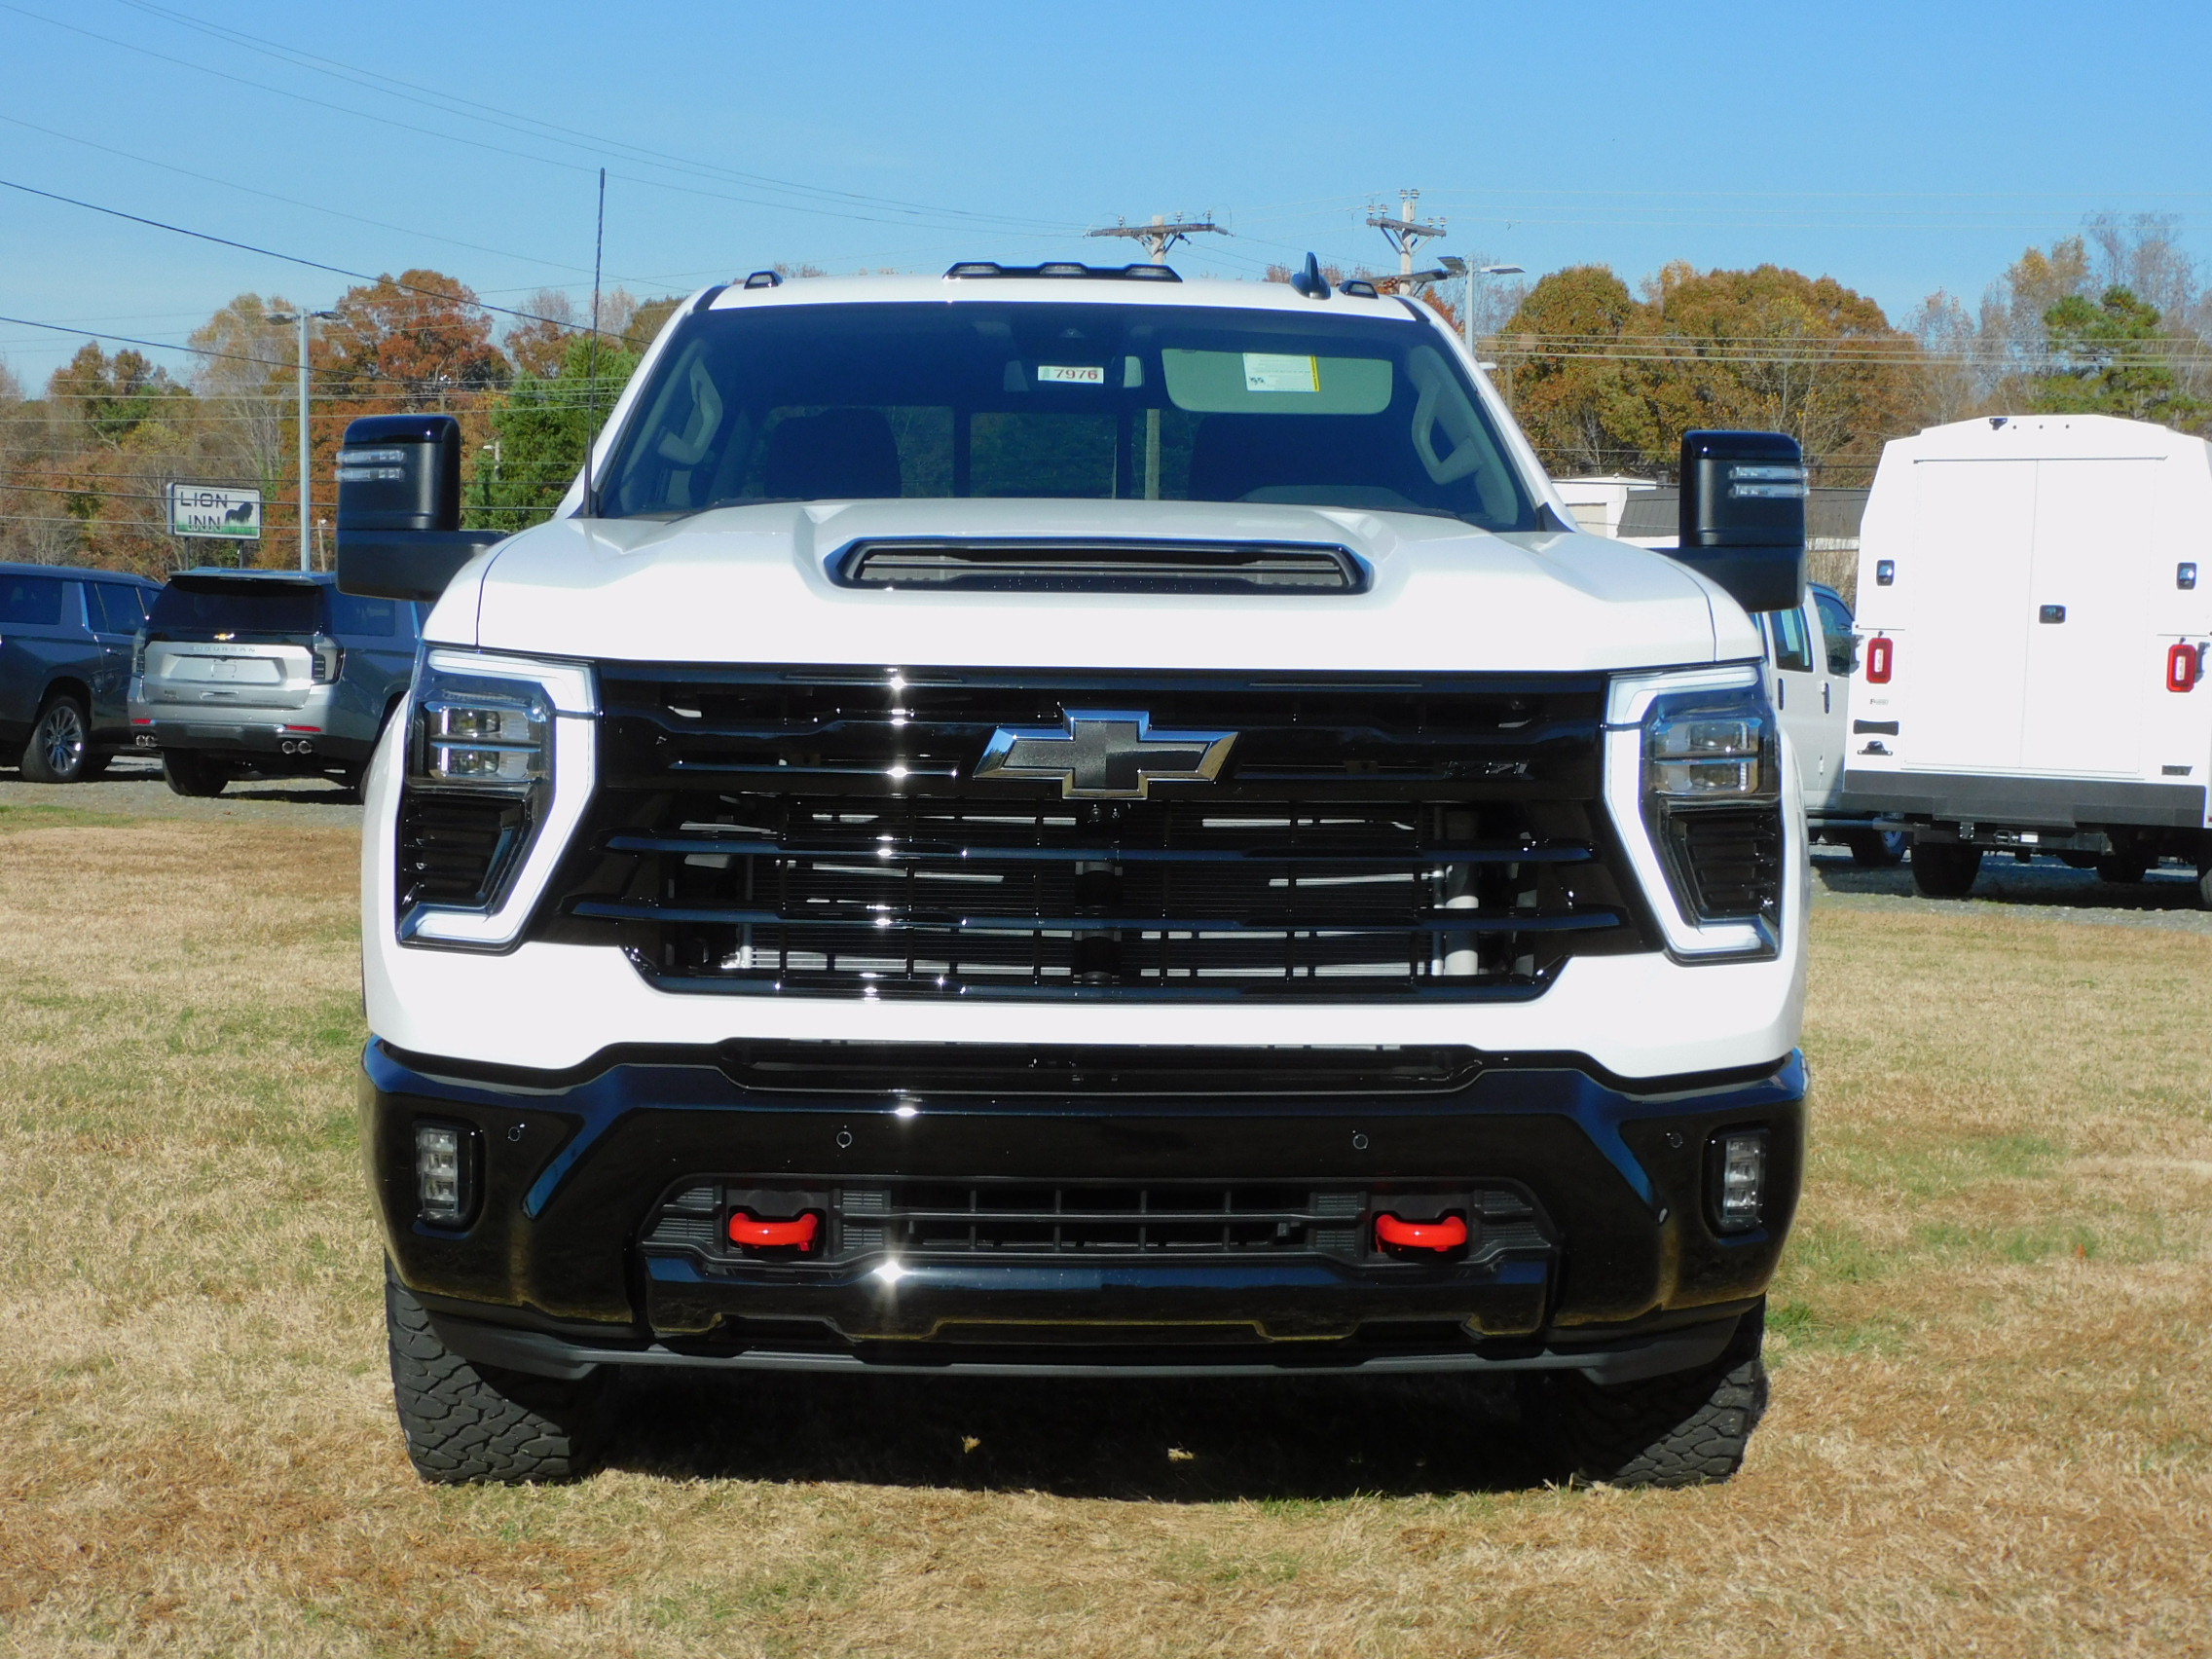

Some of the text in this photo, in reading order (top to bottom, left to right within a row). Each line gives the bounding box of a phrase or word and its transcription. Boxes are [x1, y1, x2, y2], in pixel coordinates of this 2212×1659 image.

[1053, 368, 1098, 380] 7976
[180, 491, 228, 508] LION
[188, 514, 220, 531] INN
